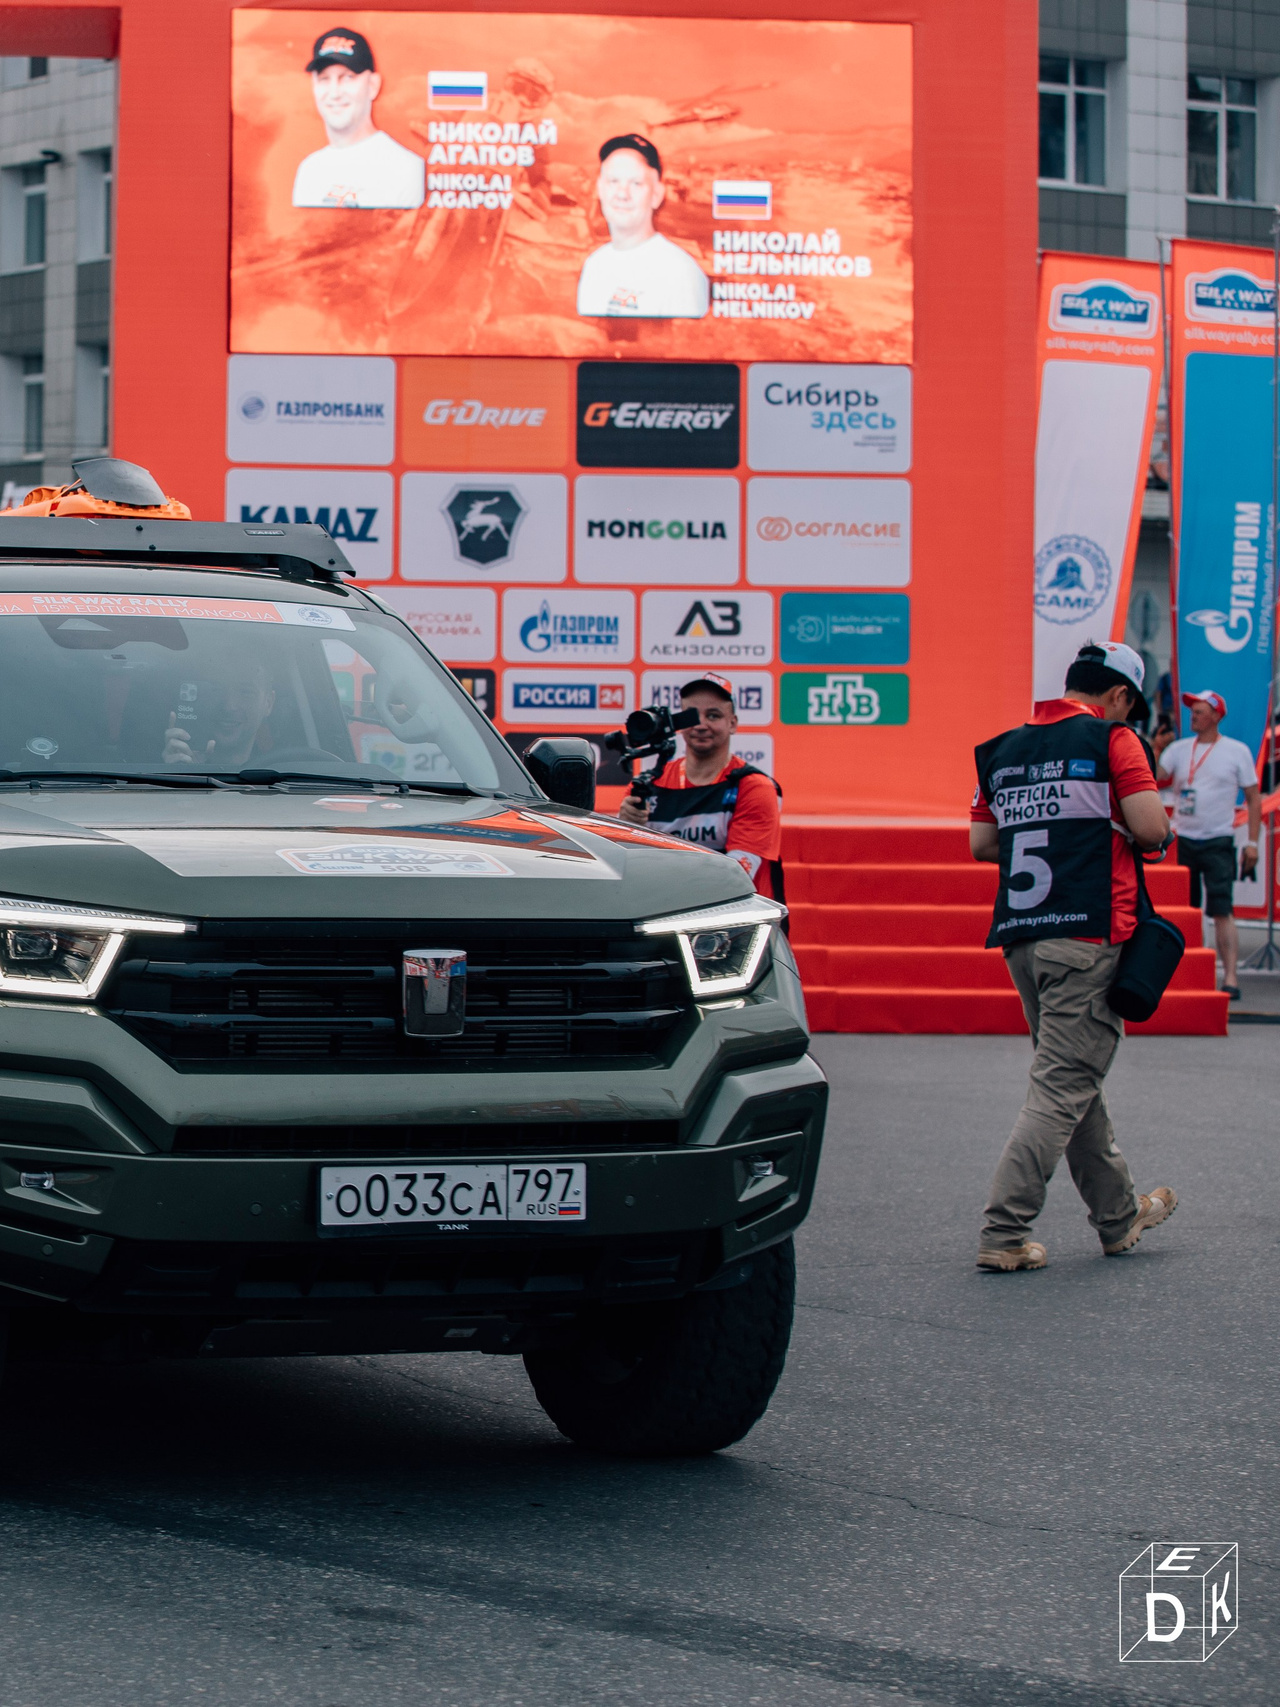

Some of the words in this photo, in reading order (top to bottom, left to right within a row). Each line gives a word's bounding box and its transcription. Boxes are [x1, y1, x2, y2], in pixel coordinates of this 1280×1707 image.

[427, 118, 558, 145] НИКОЛАЙ
[427, 143, 535, 167] АГАПОВ
[427, 173, 512, 192] NIKOLAI
[427, 190, 513, 210] AGAPOV
[713, 228, 841, 254] НИКОЛАЙ
[713, 252, 872, 277] МЕЛЬНИКОВ
[712, 282, 795, 301] NIKOLAI
[1196, 285, 1236, 301] SILK
[1238, 289, 1275, 304] WAY
[712, 300, 816, 320] MELNIKOV
[1062, 296, 1107, 311] SILK
[1108, 299, 1148, 315] WAY
[764, 382, 880, 412] Сибирь
[276, 400, 385, 419] ГАЗПРОМБАНК
[810, 410, 897, 433] здесь
[587, 520, 728, 540] MONGOLIA
[794, 522, 901, 539] СОГЛАСИЕ
[1229, 502, 1261, 608] ГАЗПРОМ
[31, 596, 74, 605] SILK
[78, 597, 124, 606] WAY
[127, 598, 189, 607] RALLY
[1034, 593, 1095, 609] CAMF
[76, 604, 152, 615] EDITION
[174, 607, 277, 621] MONGOLIA
[553, 615, 619, 633] ГАЗПРОМ
[519, 687, 591, 706] РОССИЯ
[599, 688, 624, 706] 24
[807, 673, 880, 724] НТВ
[1042, 759, 1065, 771] SILK
[1042, 768, 1064, 780] WAY
[995, 783, 1070, 808] OFFICIAL
[1003, 801, 1061, 823] PHOTO
[306, 852, 389, 861] SILK
[393, 853, 470, 861] WAY
[380, 864, 433, 873] 508
[1007, 829, 1053, 910] 5
[512, 1167, 575, 1203] 797
[526, 1202, 558, 1216] RUS
[436, 1223, 470, 1231] TANK
